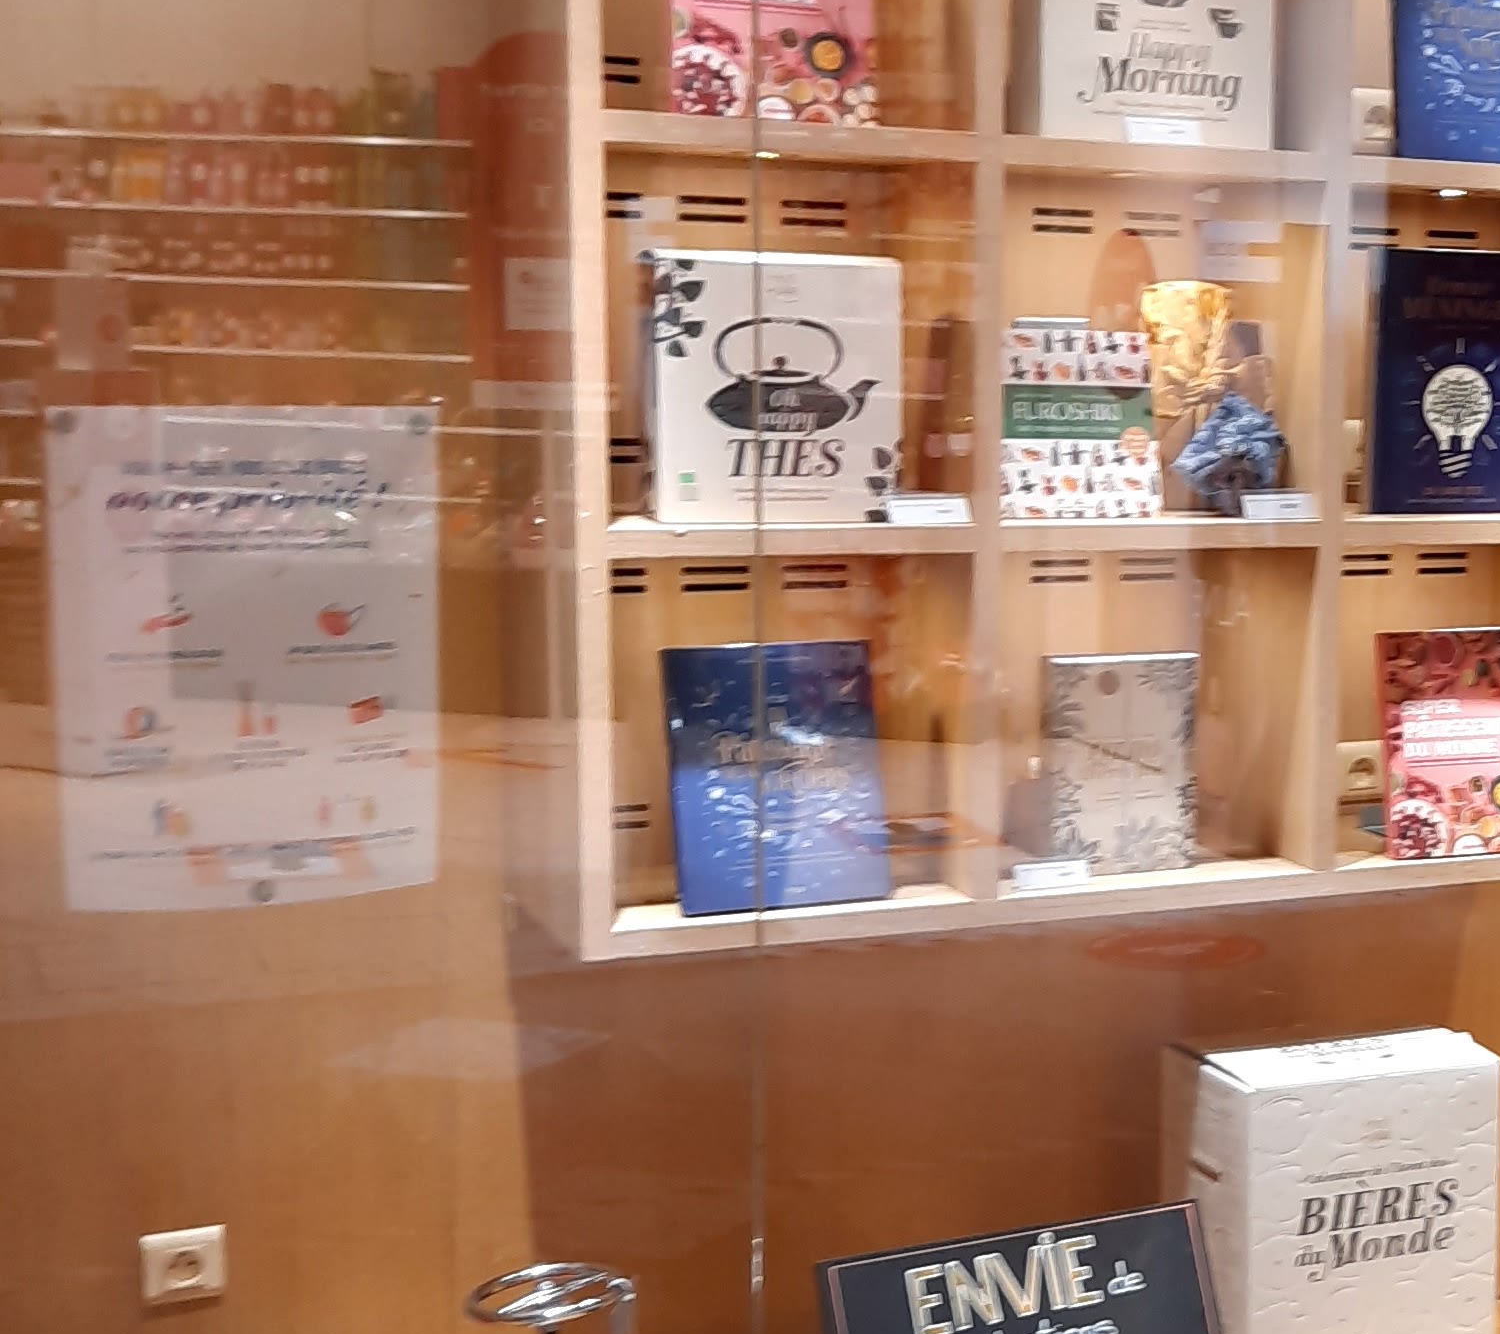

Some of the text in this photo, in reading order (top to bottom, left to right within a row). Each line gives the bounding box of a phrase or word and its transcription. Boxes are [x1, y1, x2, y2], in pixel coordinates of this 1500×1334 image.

[1075, 55, 1243, 112] Morning
[1296, 1178, 1460, 1237] BIÈRES
[1106, 1259, 1149, 1296] de
[1306, 1217, 1457, 1283] Monde
